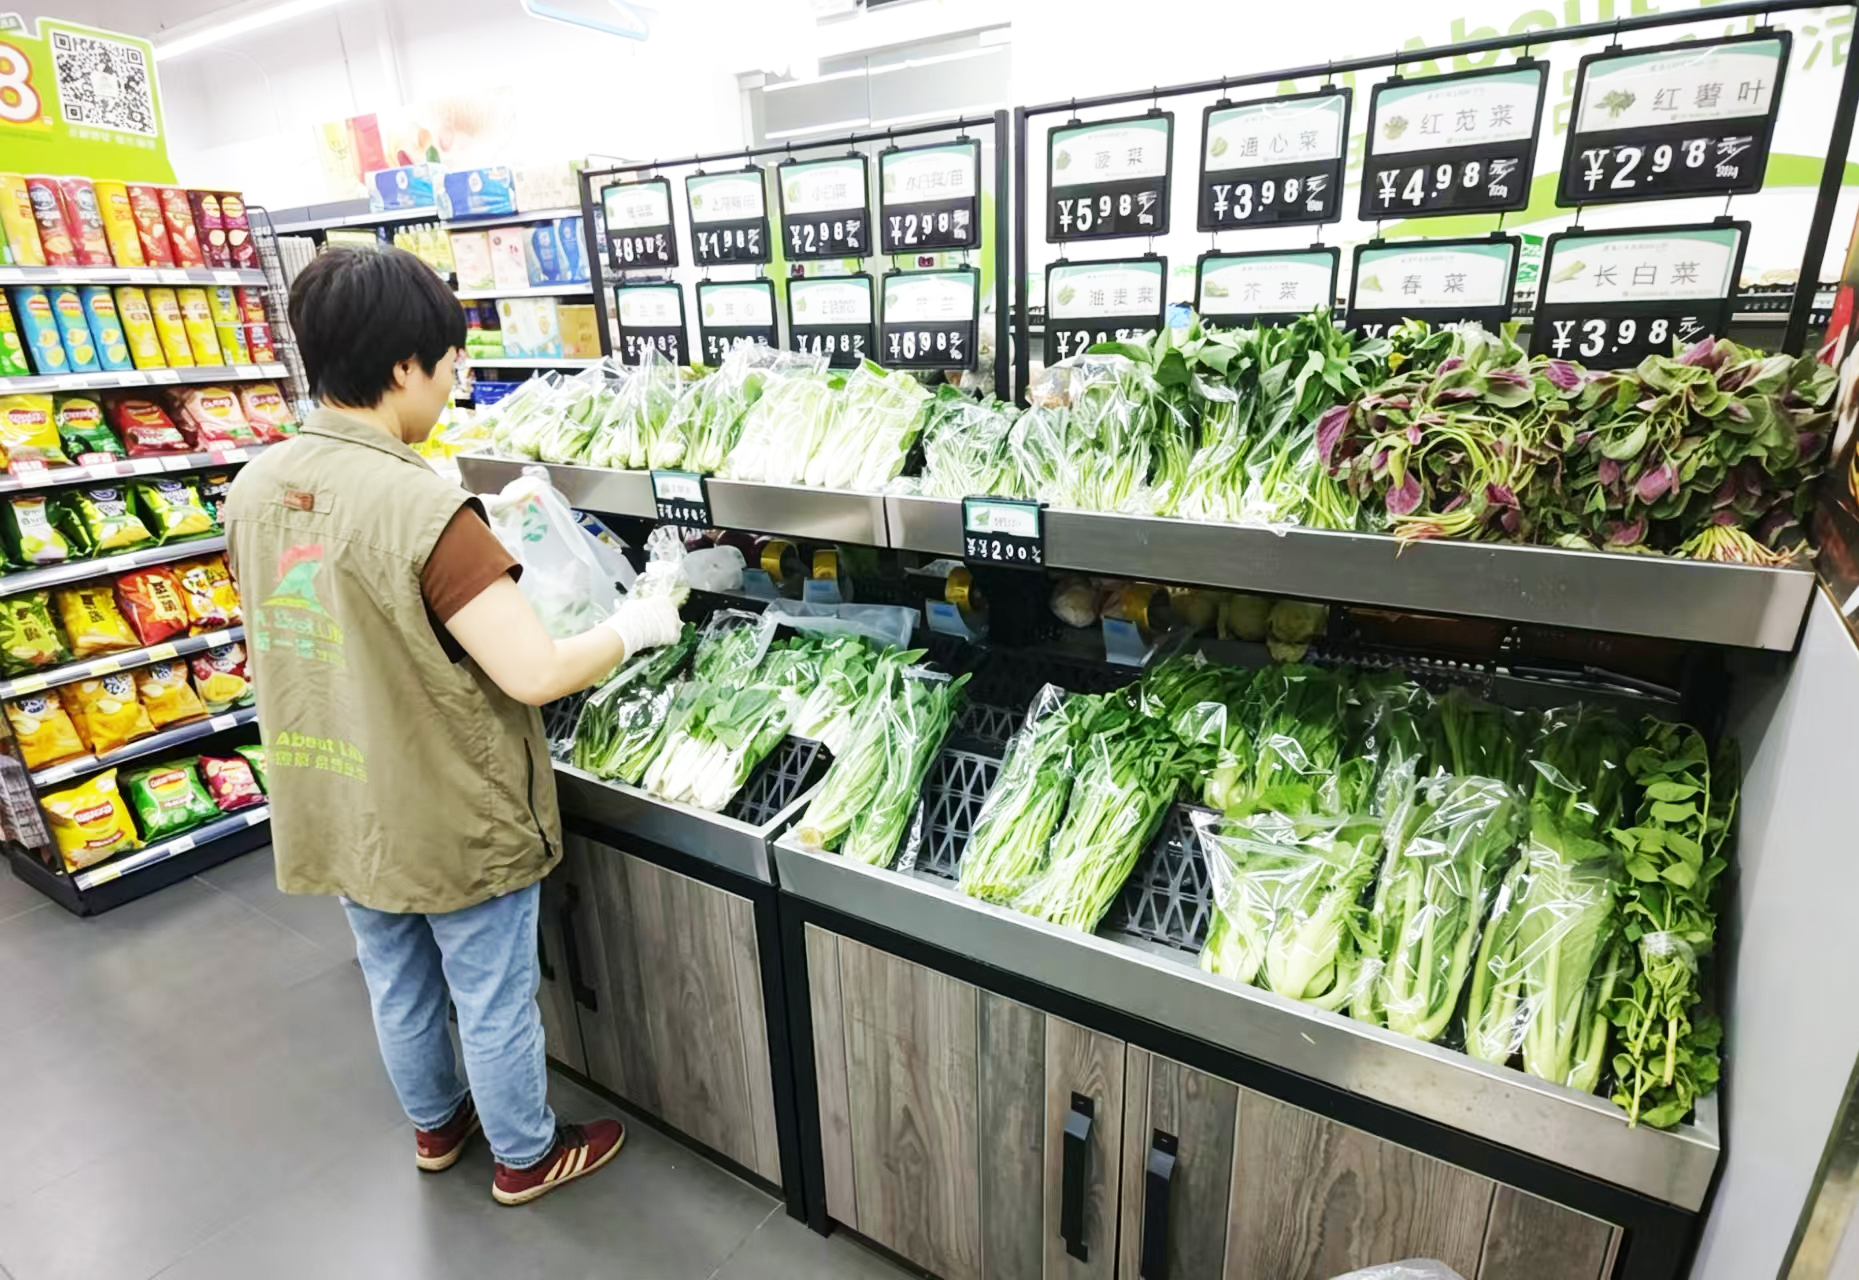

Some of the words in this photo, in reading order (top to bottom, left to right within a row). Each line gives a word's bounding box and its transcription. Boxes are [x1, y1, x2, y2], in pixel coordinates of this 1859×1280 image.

[1652, 79, 1767, 112] 红薯叶
[1419, 104, 1515, 135] 红苋菜
[1240, 130, 1319, 158] 通心菜
[1581, 138, 1708, 192] ¥2.98
[1212, 178, 1300, 221] ¥3.98
[1377, 161, 1481, 208] ¥4.98
[1057, 193, 1132, 232] ¥5.98
[1401, 272, 1468, 296] 春菜
[1593, 261, 1700, 288] 长白菜
[1552, 317, 1669, 358] ¥3.98
